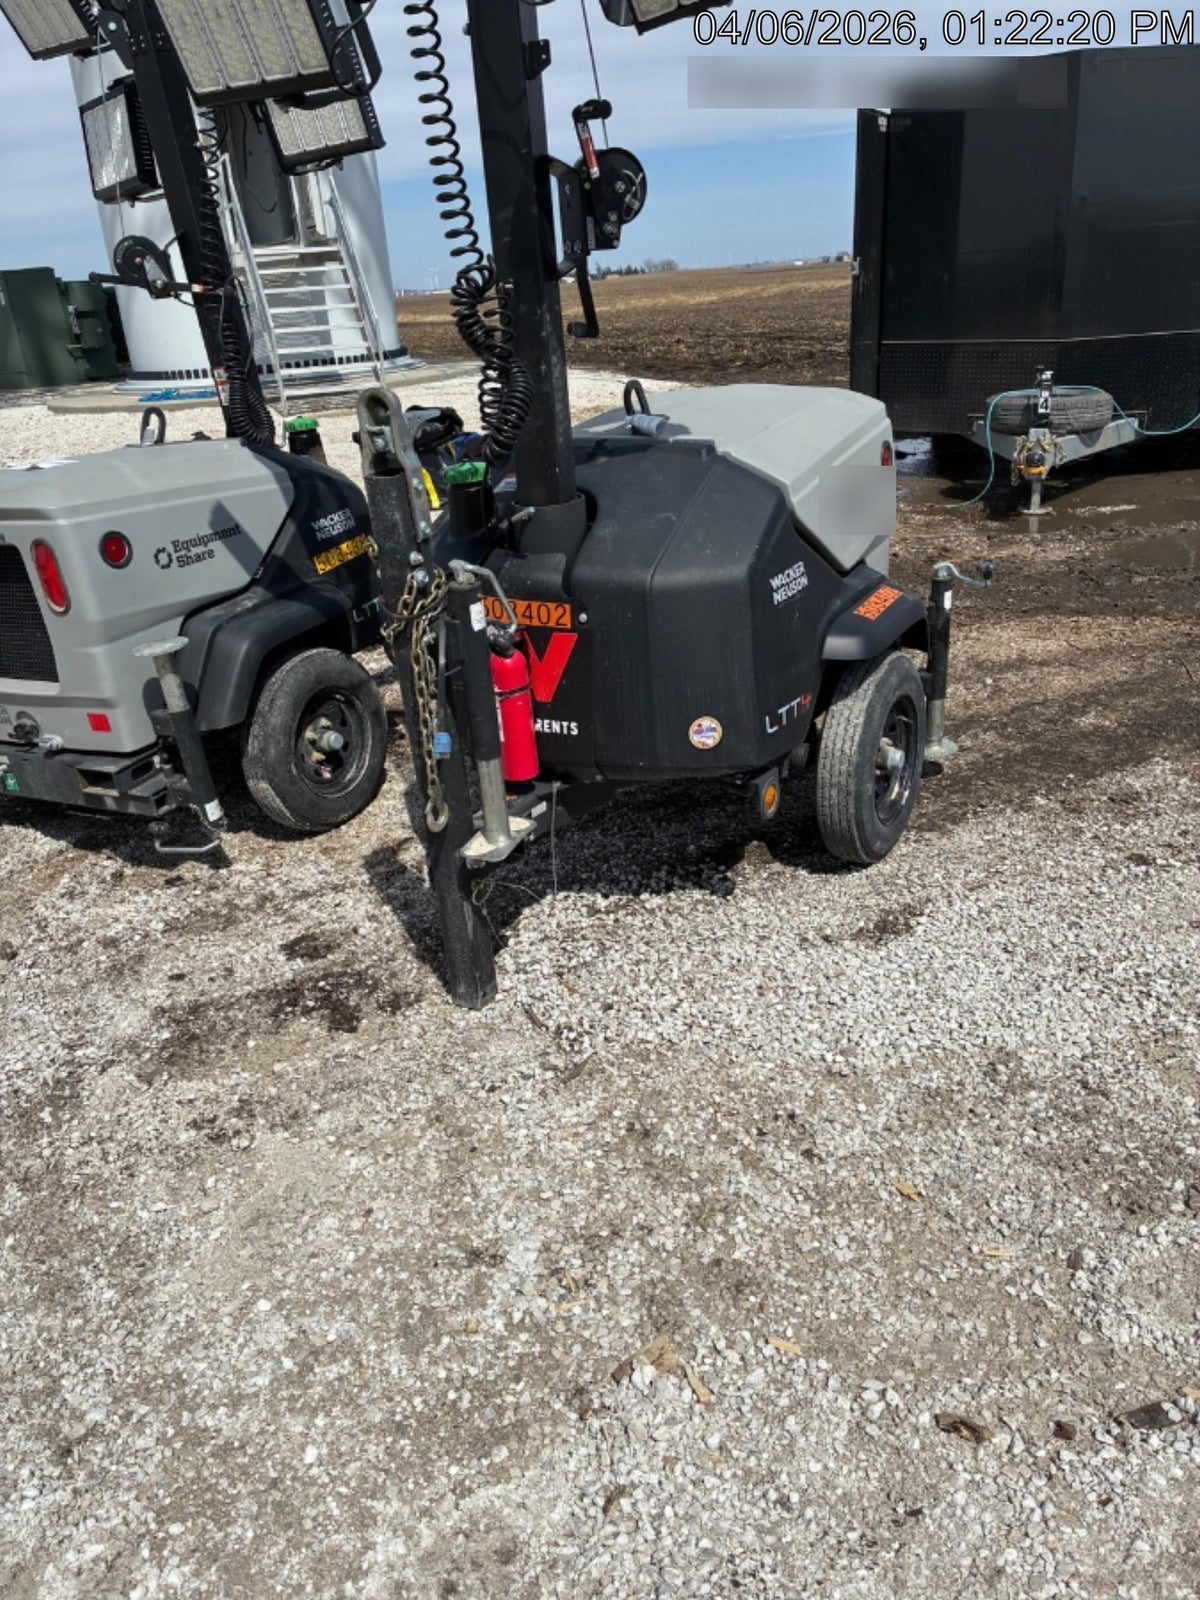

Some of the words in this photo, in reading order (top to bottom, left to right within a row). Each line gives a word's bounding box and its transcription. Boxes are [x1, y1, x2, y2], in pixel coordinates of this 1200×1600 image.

[310, 507, 353, 531] WACKER
[315, 519, 356, 541] NEUSON
[171, 523, 242, 554] Equipment
[176, 549, 216, 568] Share
[769, 561, 806, 590] WACKER
[772, 574, 809, 606] NEUSON
[765, 693, 812, 734] LTT4
